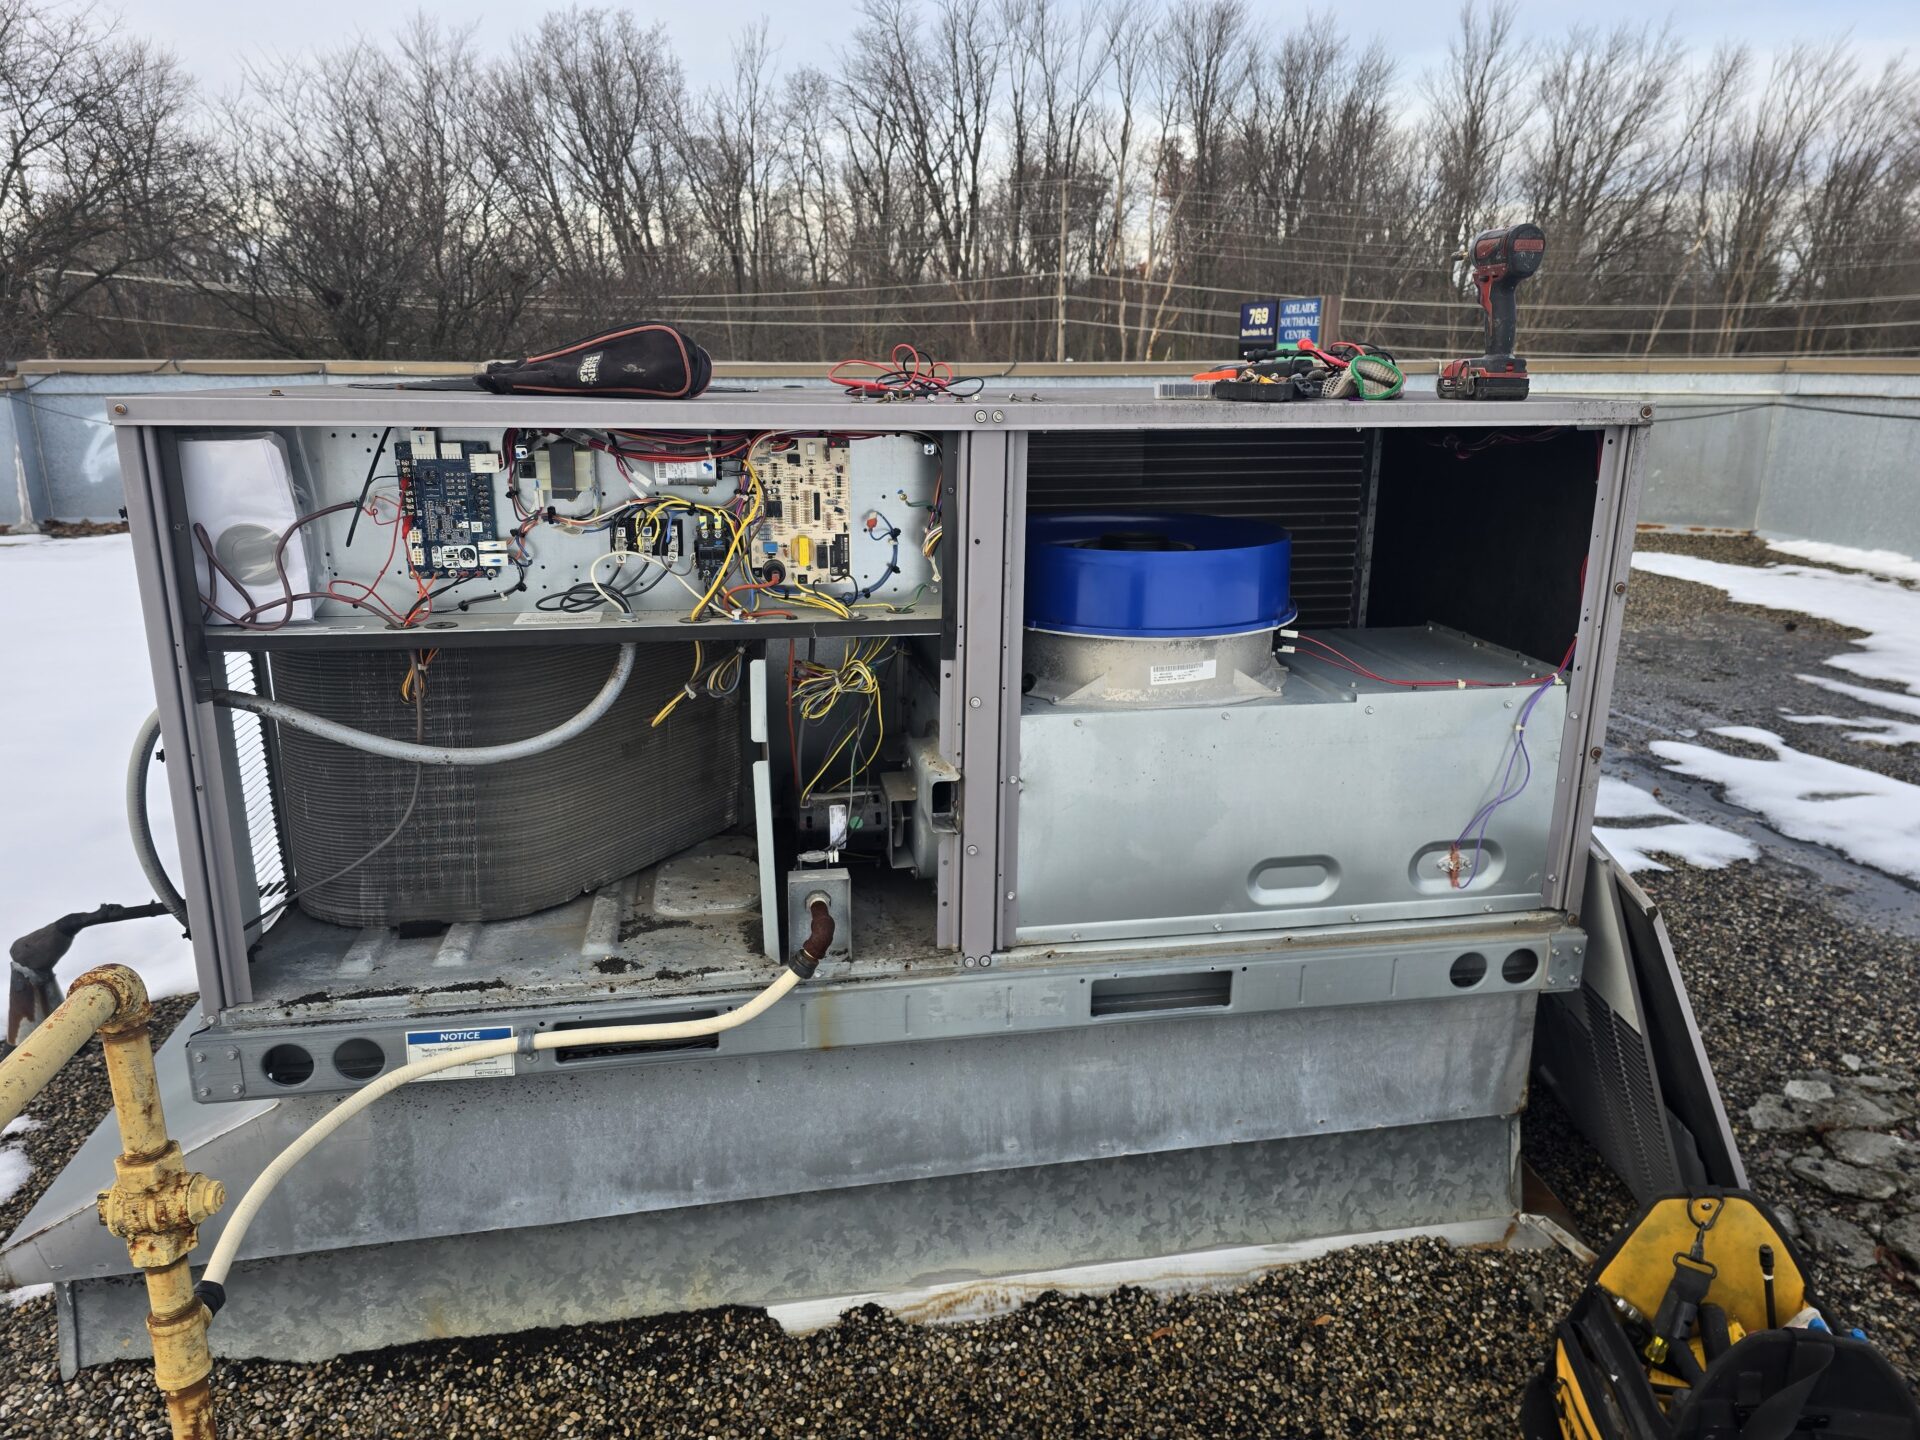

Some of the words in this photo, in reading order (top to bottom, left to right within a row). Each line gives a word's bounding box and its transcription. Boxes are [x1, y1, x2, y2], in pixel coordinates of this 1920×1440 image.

[1284, 302, 1317, 314] ADELAIDE
[1249, 307, 1269, 325] 769
[1280, 316, 1320, 327] SOUTHDALE
[1285, 330, 1311, 339] CENTRE
[440, 1031, 481, 1042] NOTICE
